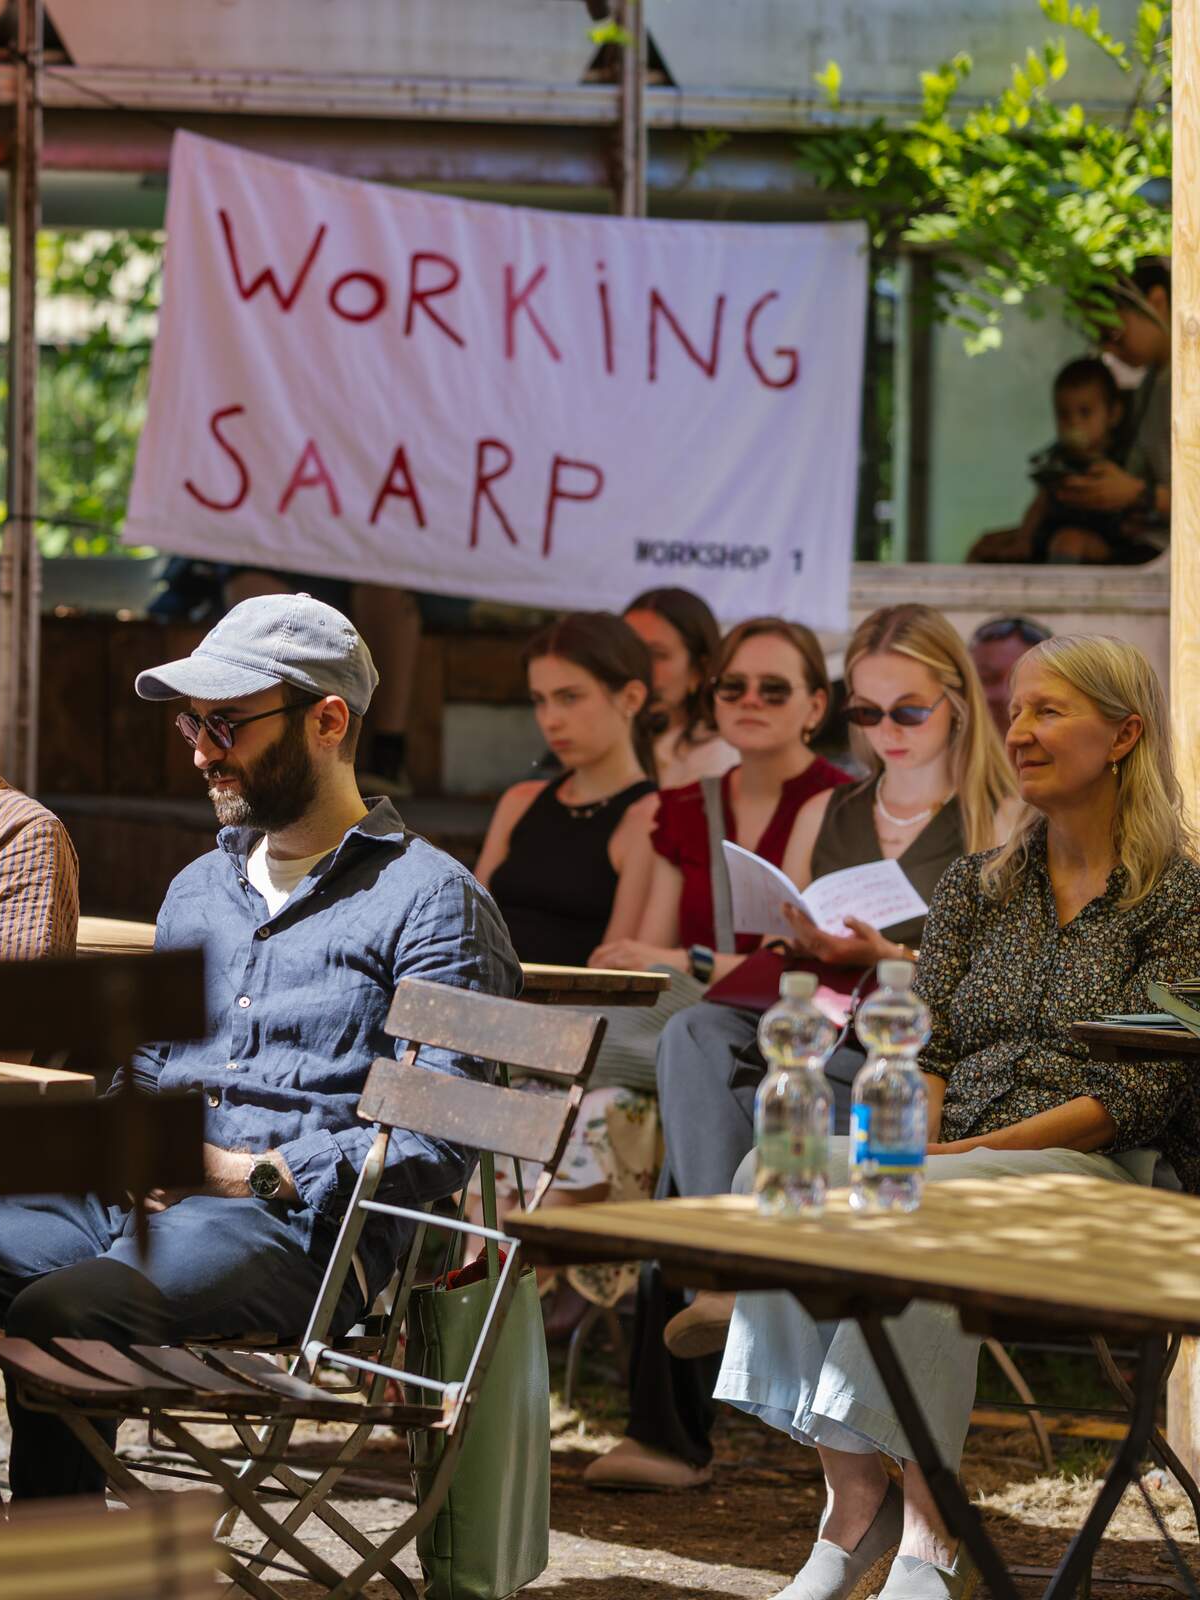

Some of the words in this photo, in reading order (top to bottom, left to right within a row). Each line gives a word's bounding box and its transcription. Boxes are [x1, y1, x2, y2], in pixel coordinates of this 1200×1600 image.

[184, 404, 604, 559] SAARP
[635, 539, 770, 570] WORKSHOP
[791, 549, 804, 573] 1
